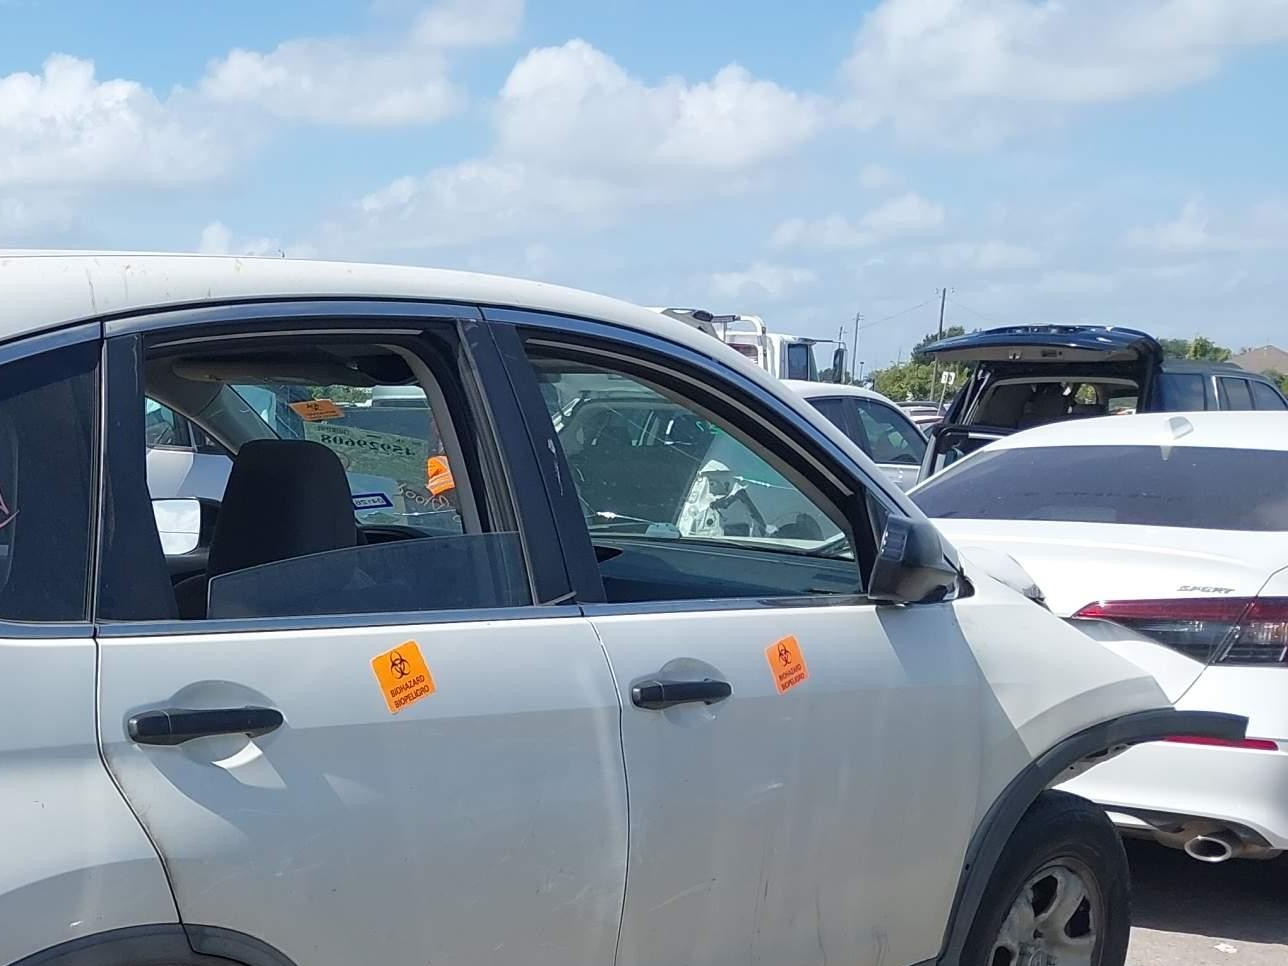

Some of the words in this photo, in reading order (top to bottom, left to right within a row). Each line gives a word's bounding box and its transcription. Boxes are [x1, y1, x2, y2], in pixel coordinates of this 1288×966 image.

[1176, 585, 1236, 594] SPORT
[390, 674, 425, 697] BIOHAZARD
[394, 684, 430, 708] BIOPELIGRO
